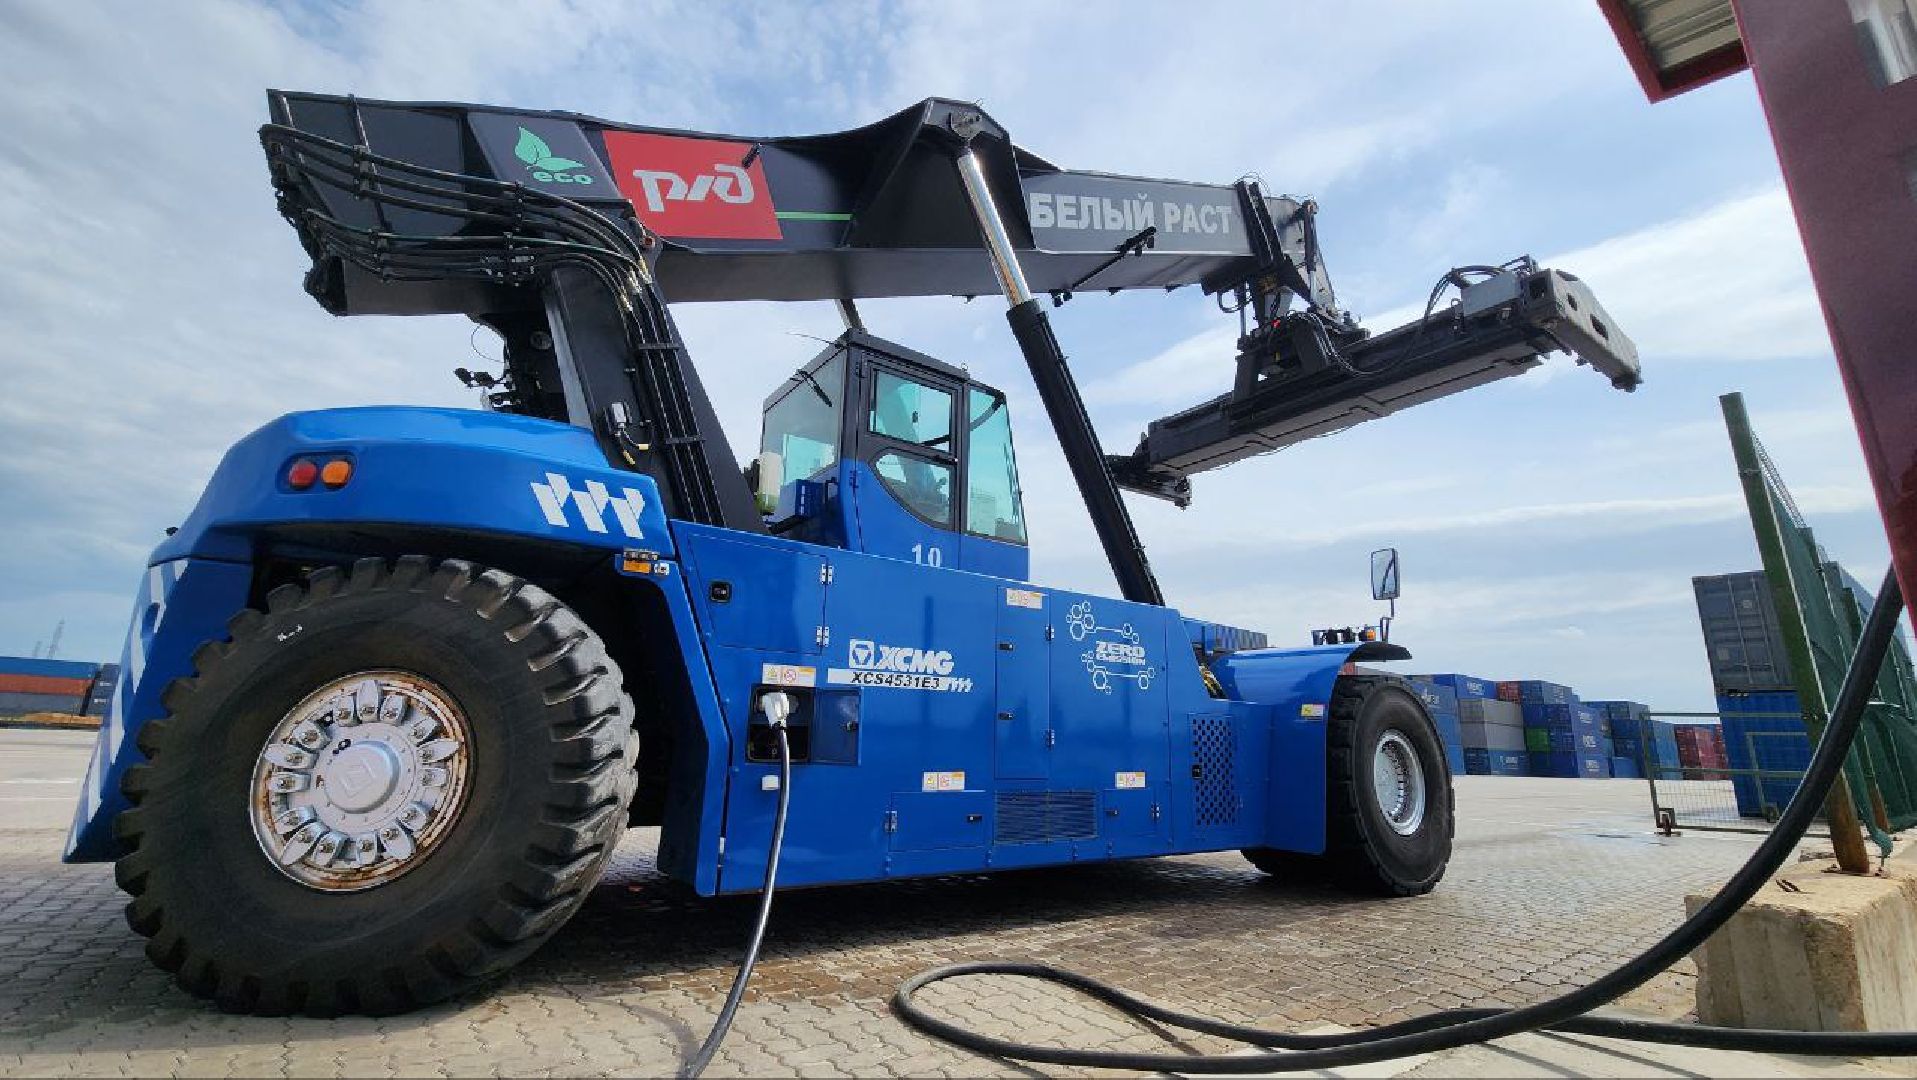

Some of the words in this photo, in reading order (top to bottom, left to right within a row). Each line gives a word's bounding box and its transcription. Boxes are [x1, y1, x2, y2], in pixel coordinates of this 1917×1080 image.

[533, 170, 593, 185] eco
[1029, 192, 1154, 230] БЕЛЫЙ
[1164, 202, 1232, 234] РАСТ
[911, 543, 941, 568] 10
[875, 644, 955, 675] XCMG
[1095, 641, 1146, 657] ZERO
[851, 671, 941, 689] XCS4531E3
